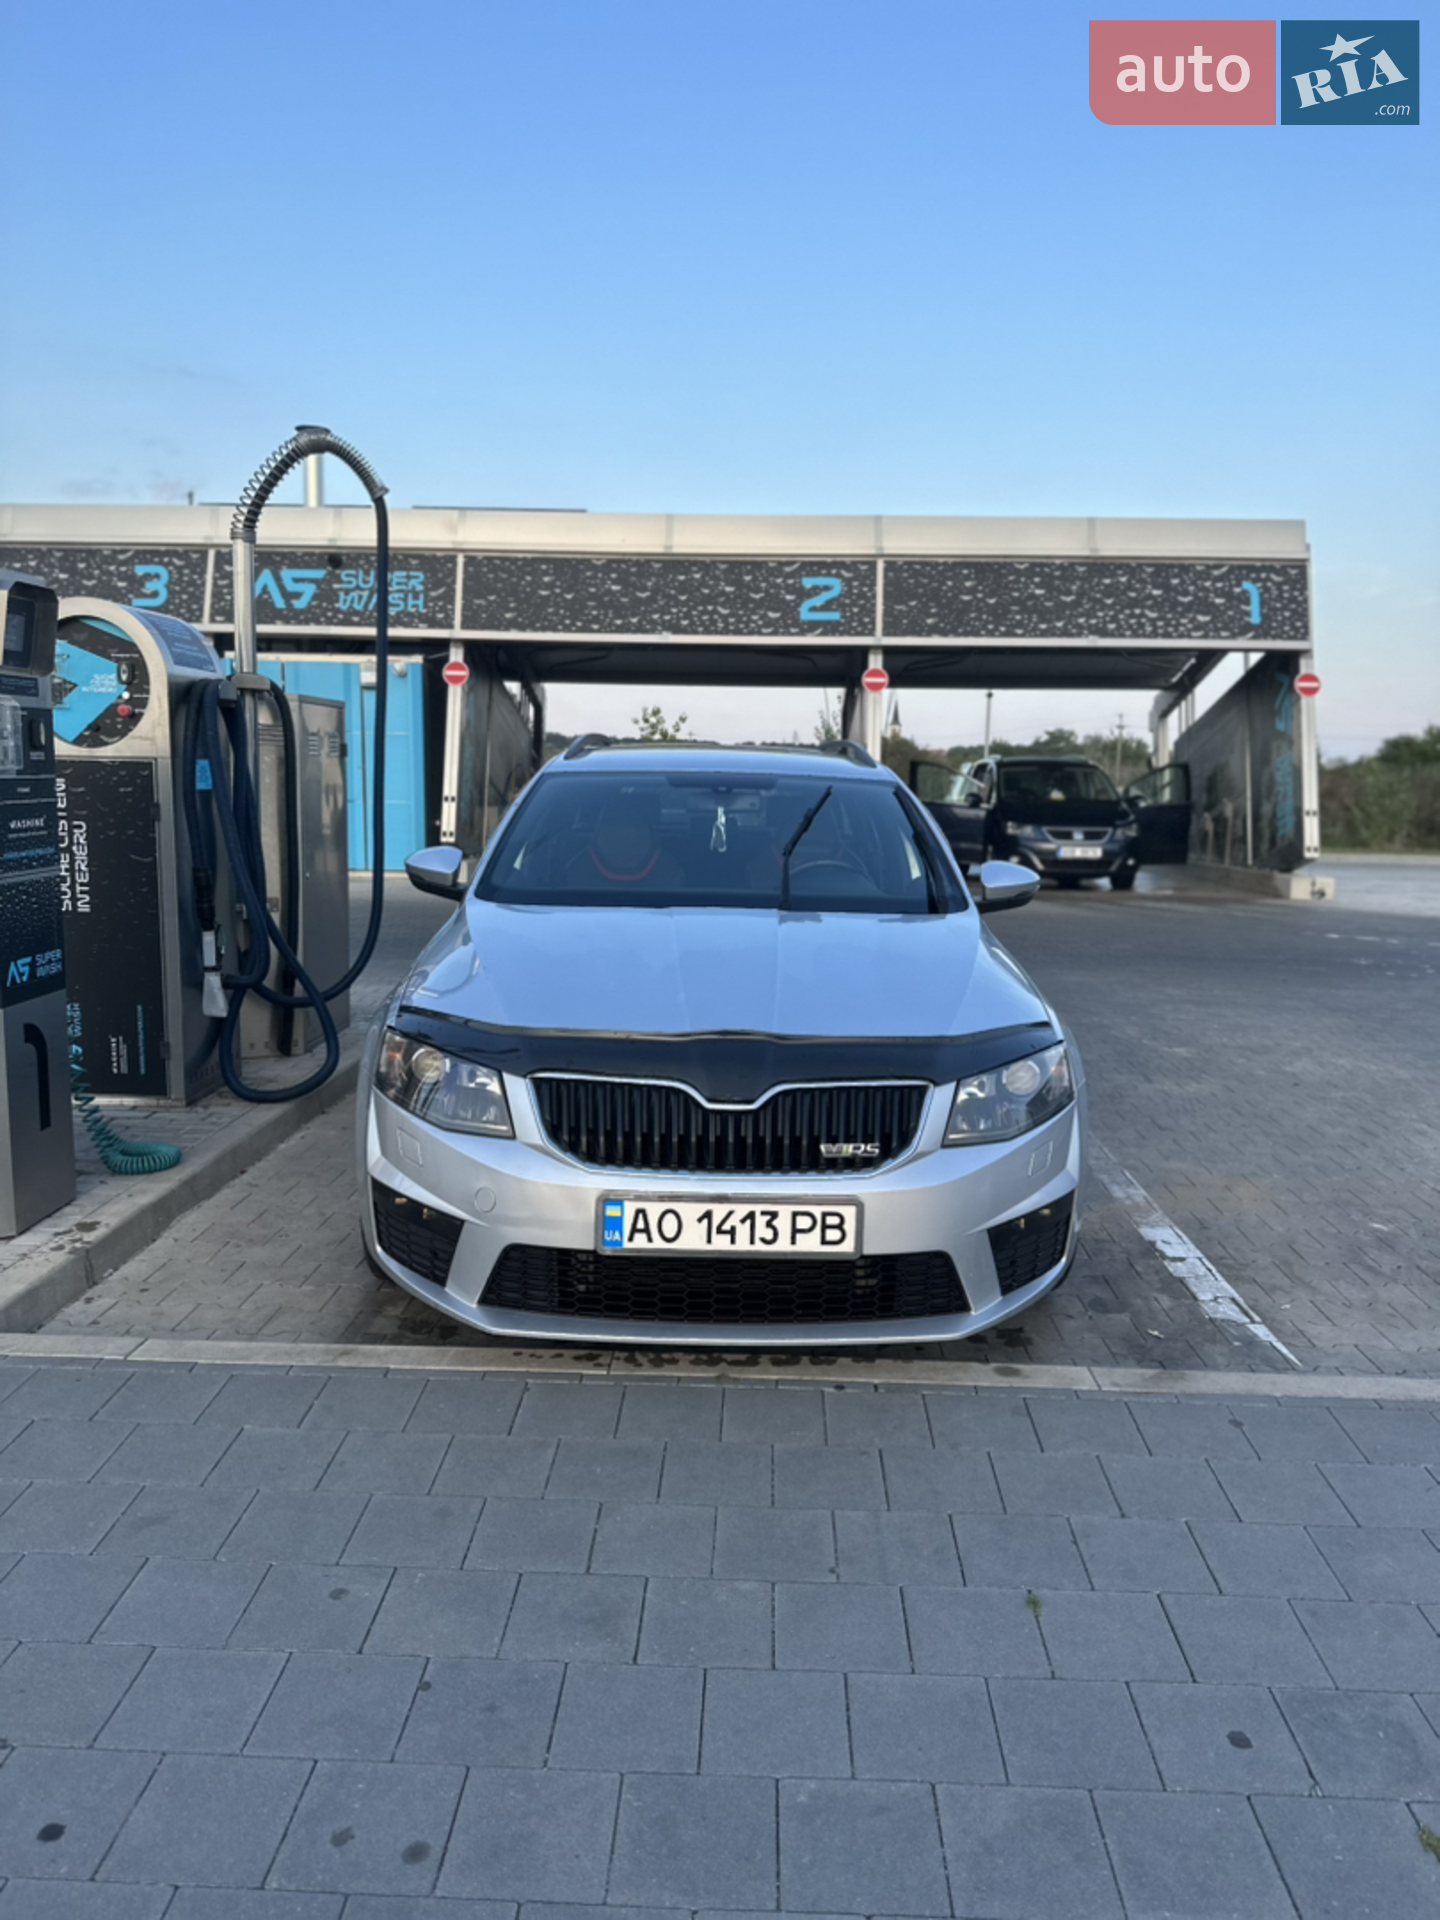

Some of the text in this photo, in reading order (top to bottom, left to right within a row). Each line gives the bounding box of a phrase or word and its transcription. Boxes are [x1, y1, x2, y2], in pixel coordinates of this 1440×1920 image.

[132, 565, 168, 608] 3
[340, 569, 424, 590] SUER
[800, 576, 840, 620] 2
[1242, 580, 1260, 624] 1
[604, 1229, 622, 1242] UA
[627, 1208, 847, 1246] AO 1413 PB
